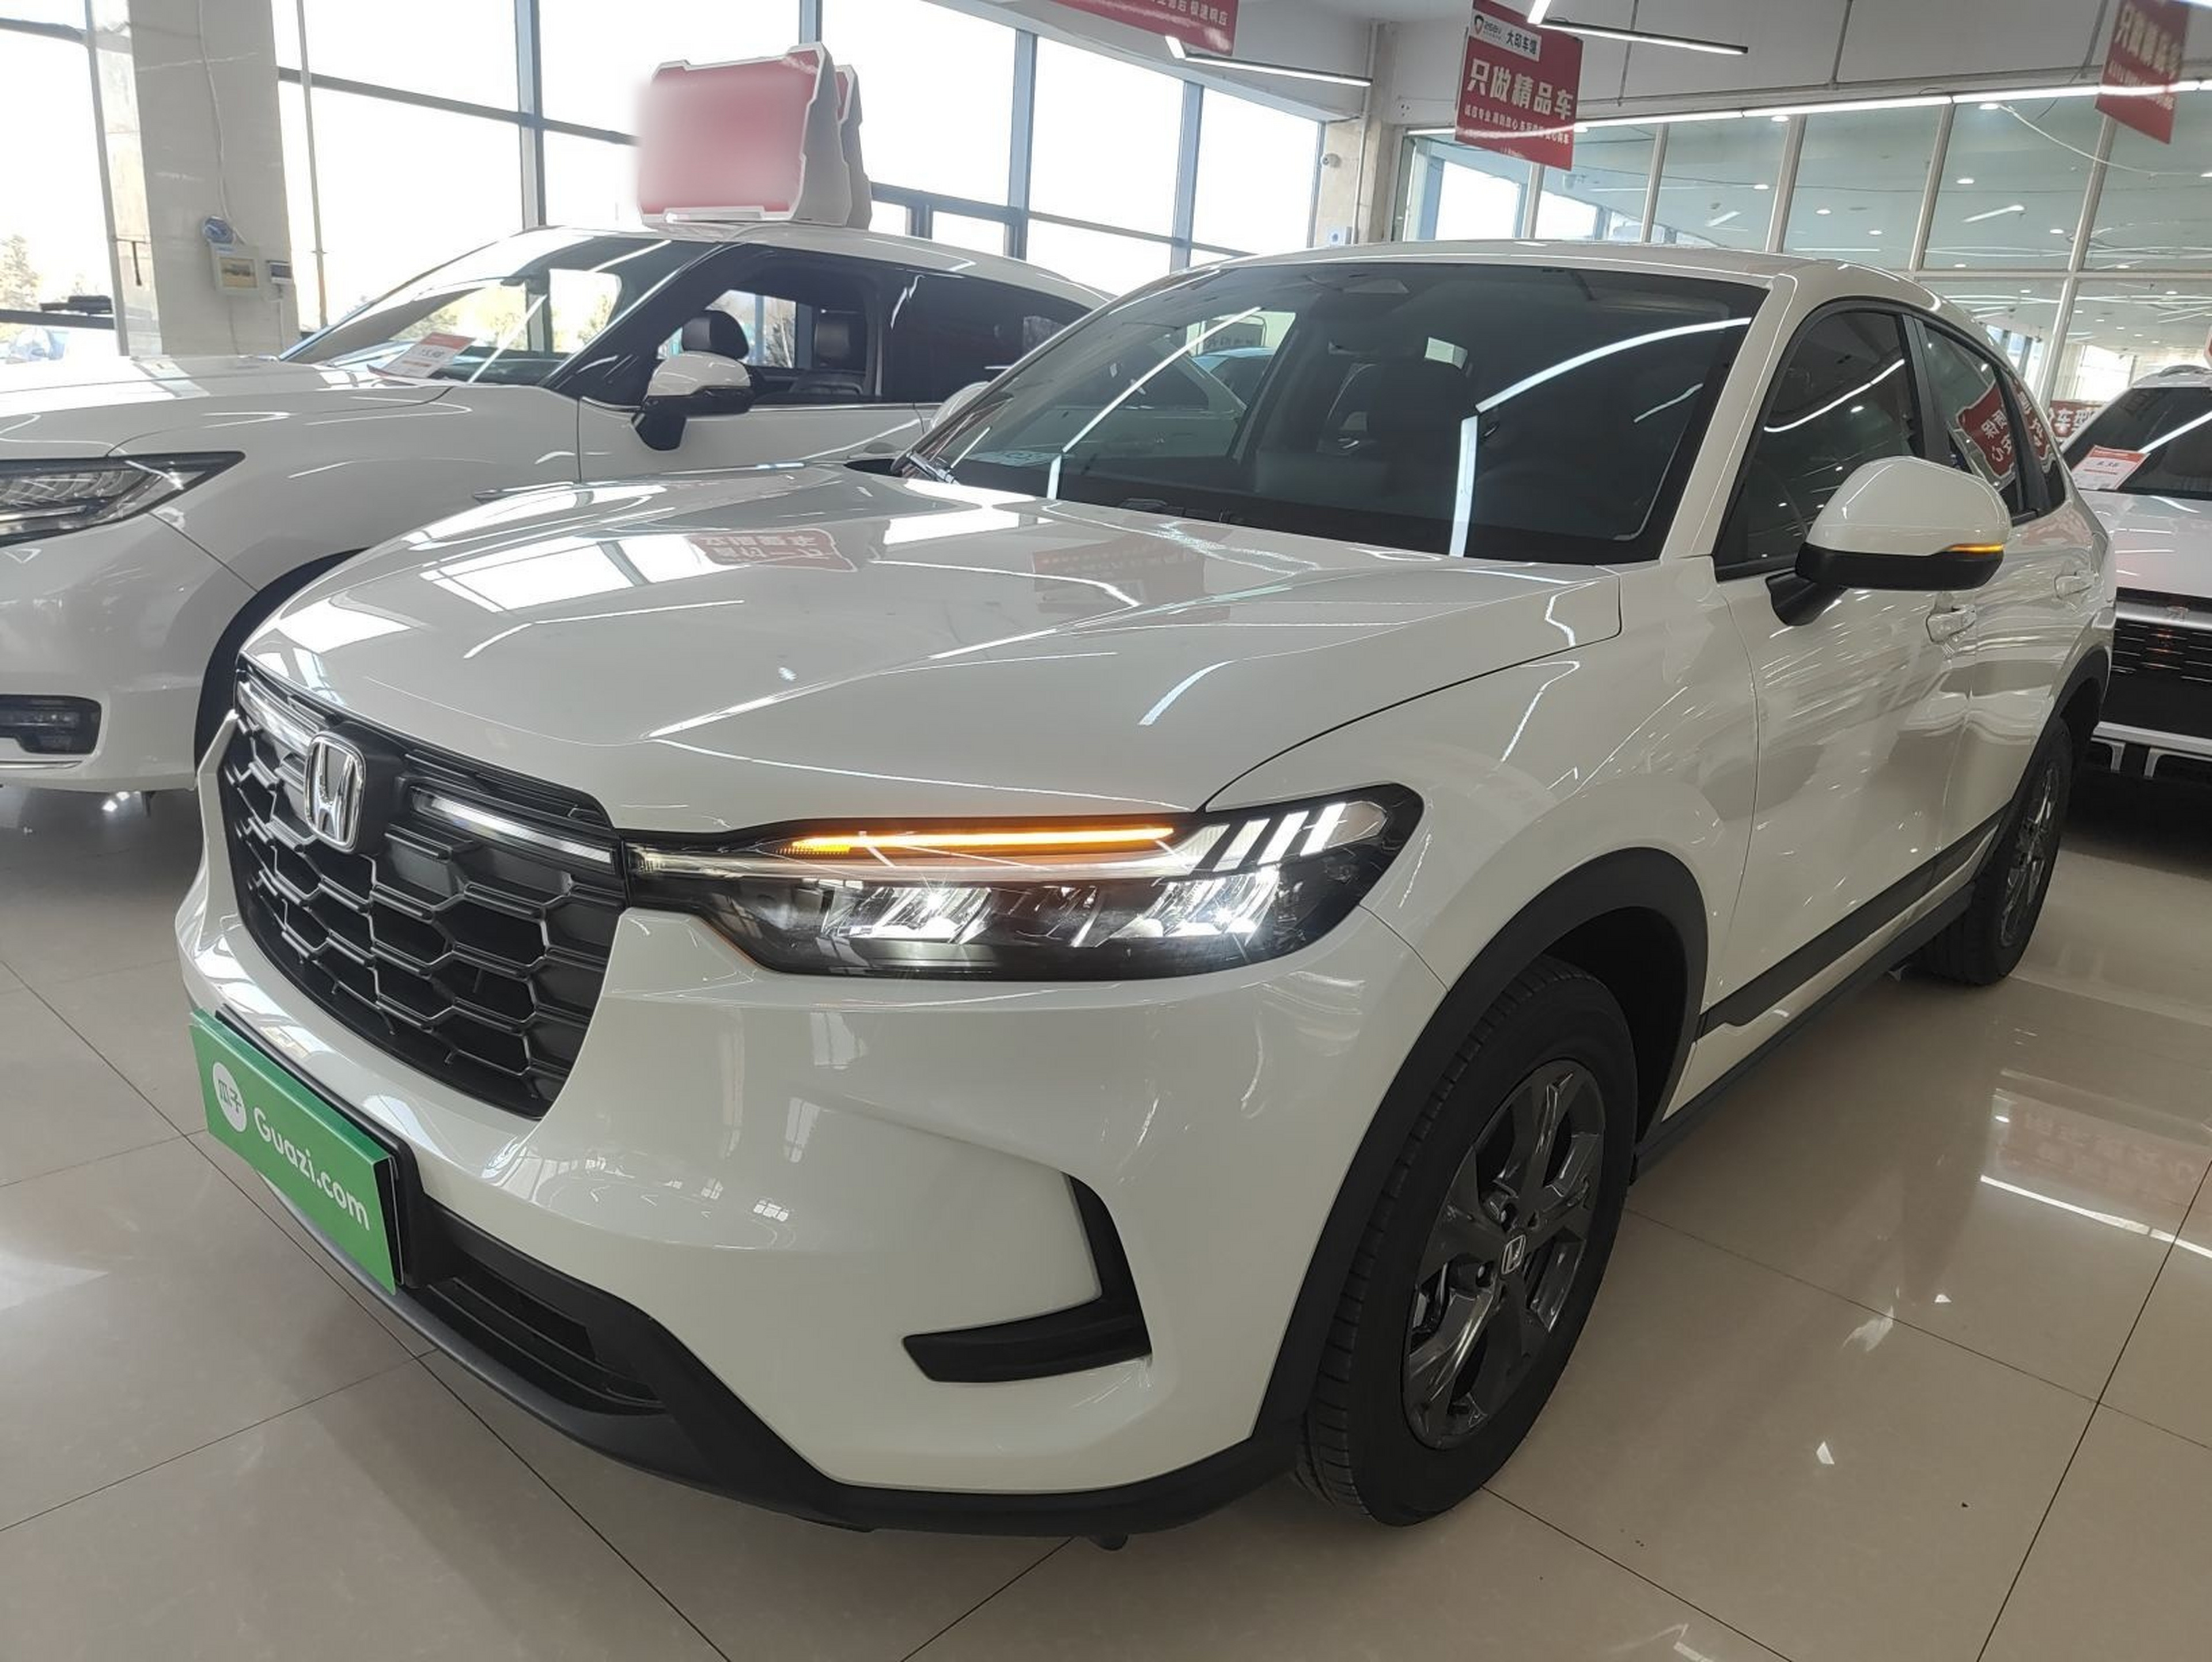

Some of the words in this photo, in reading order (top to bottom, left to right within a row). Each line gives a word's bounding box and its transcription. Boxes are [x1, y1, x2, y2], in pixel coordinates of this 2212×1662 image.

[1467, 58, 1573, 120] 只做精品车
[253, 1107, 370, 1231] Guazi.com
